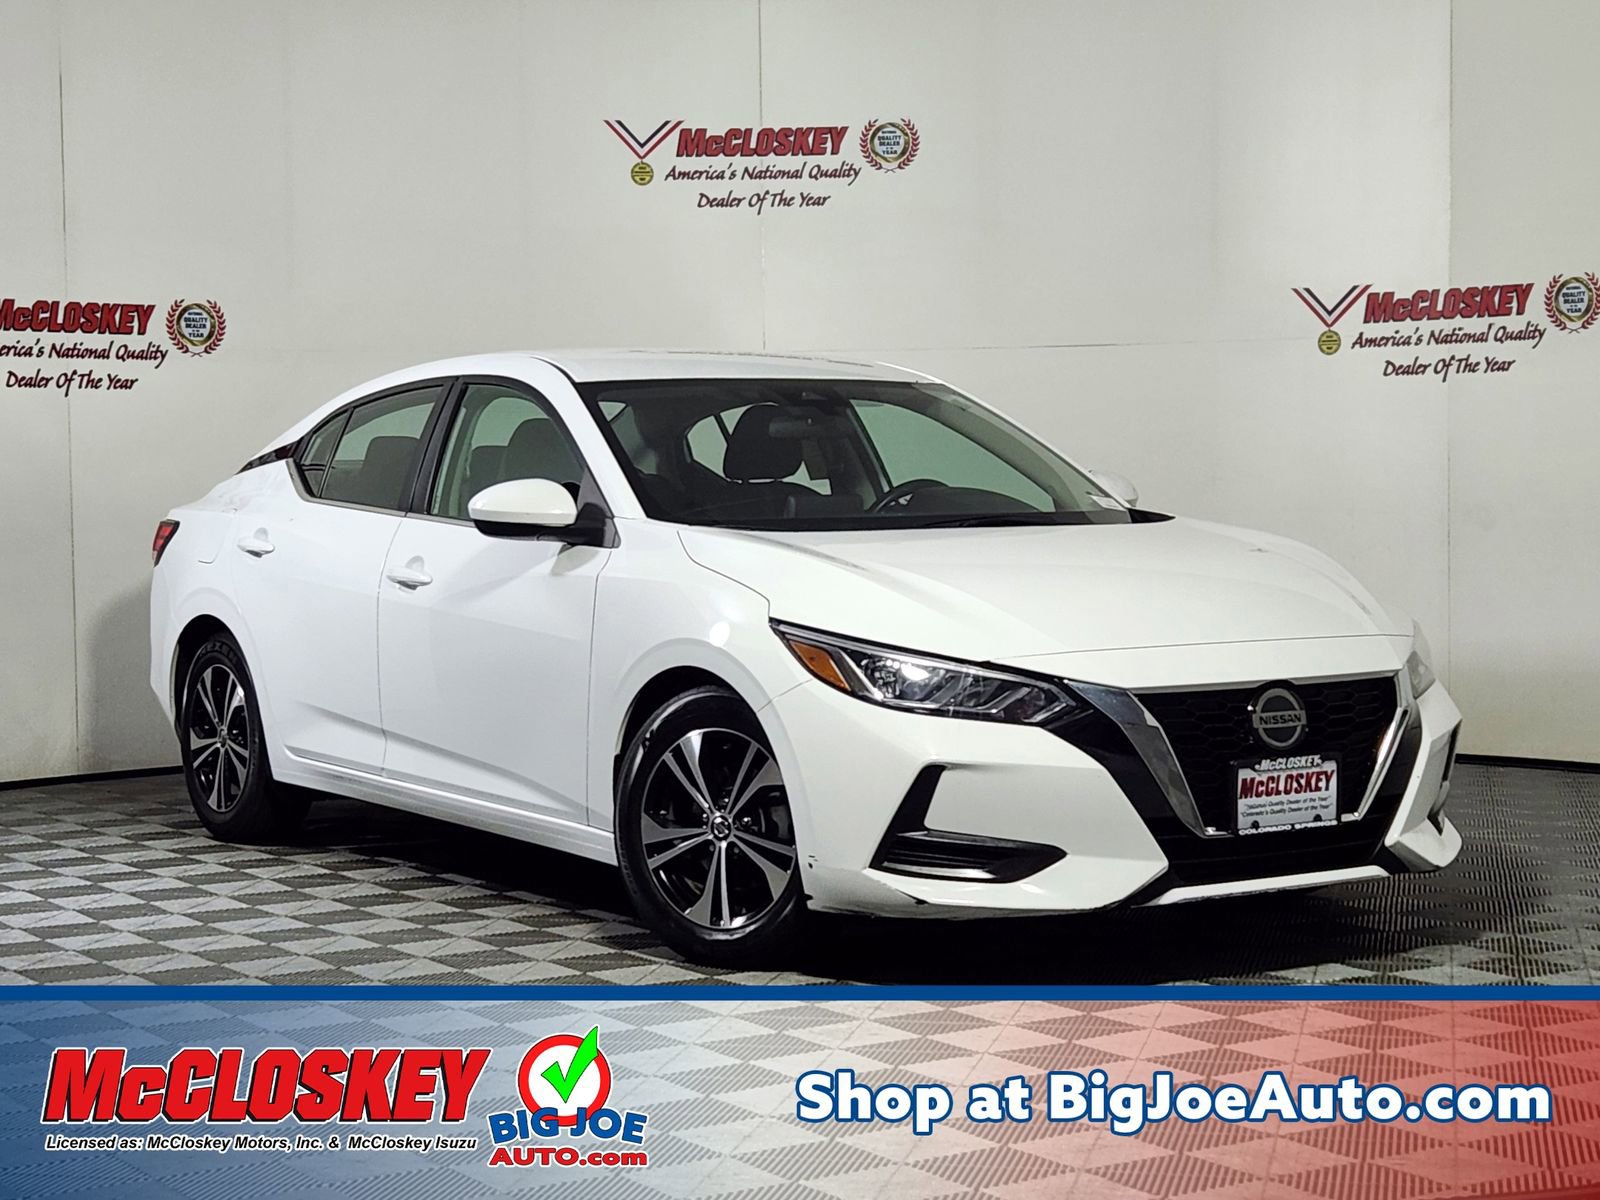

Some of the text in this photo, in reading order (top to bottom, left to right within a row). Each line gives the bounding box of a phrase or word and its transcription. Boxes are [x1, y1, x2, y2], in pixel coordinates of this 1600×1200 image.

[676, 126, 849, 157] McCLOSKEY
[664, 163, 737, 182] America's
[741, 161, 807, 181] National
[808, 161, 862, 186] Quality
[697, 190, 831, 216] Dealer Of The Year
[1363, 283, 1535, 324] McCLOSKEY
[1351, 327, 1423, 349] America's
[1427, 322, 1495, 347] National
[1494, 320, 1548, 349] Quality
[48, 340, 114, 360] National
[115, 342, 169, 369] Quality
[1383, 354, 1516, 383] Dealer Of The Year
[6, 369, 139, 398] Dealer Of The Year
[1259, 714, 1302, 726] NISSAN
[1239, 770, 1335, 799] McCLOSKEY
[1238, 824, 1292, 836] COLORADO
